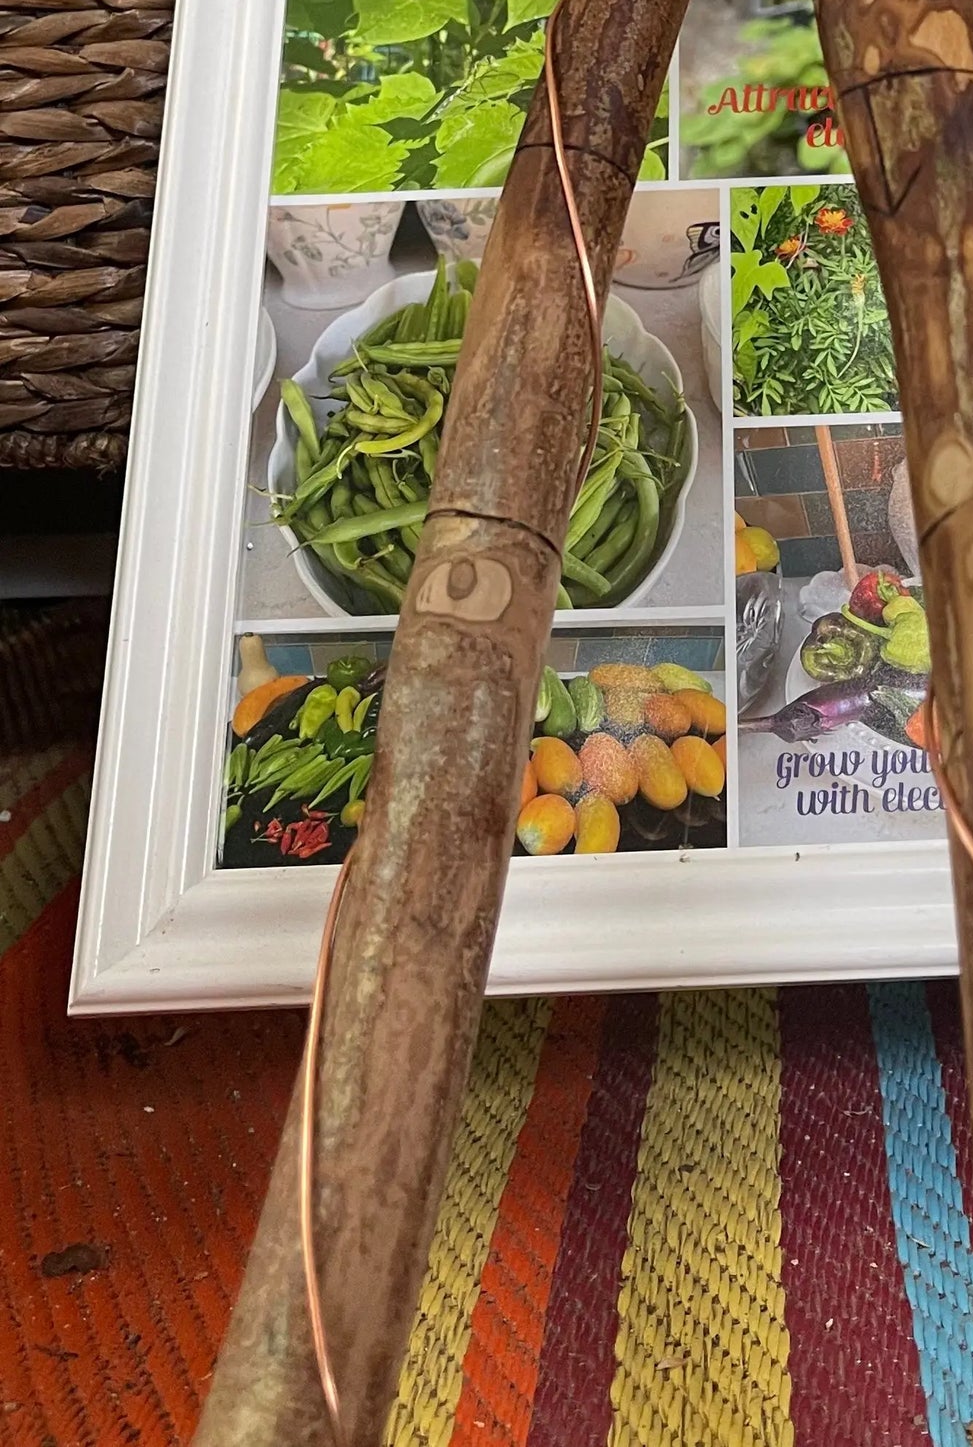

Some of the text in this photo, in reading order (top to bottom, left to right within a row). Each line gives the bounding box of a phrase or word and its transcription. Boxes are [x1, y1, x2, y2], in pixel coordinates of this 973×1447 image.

[776, 749, 934, 790] grow you
[796, 781, 875, 816] with
